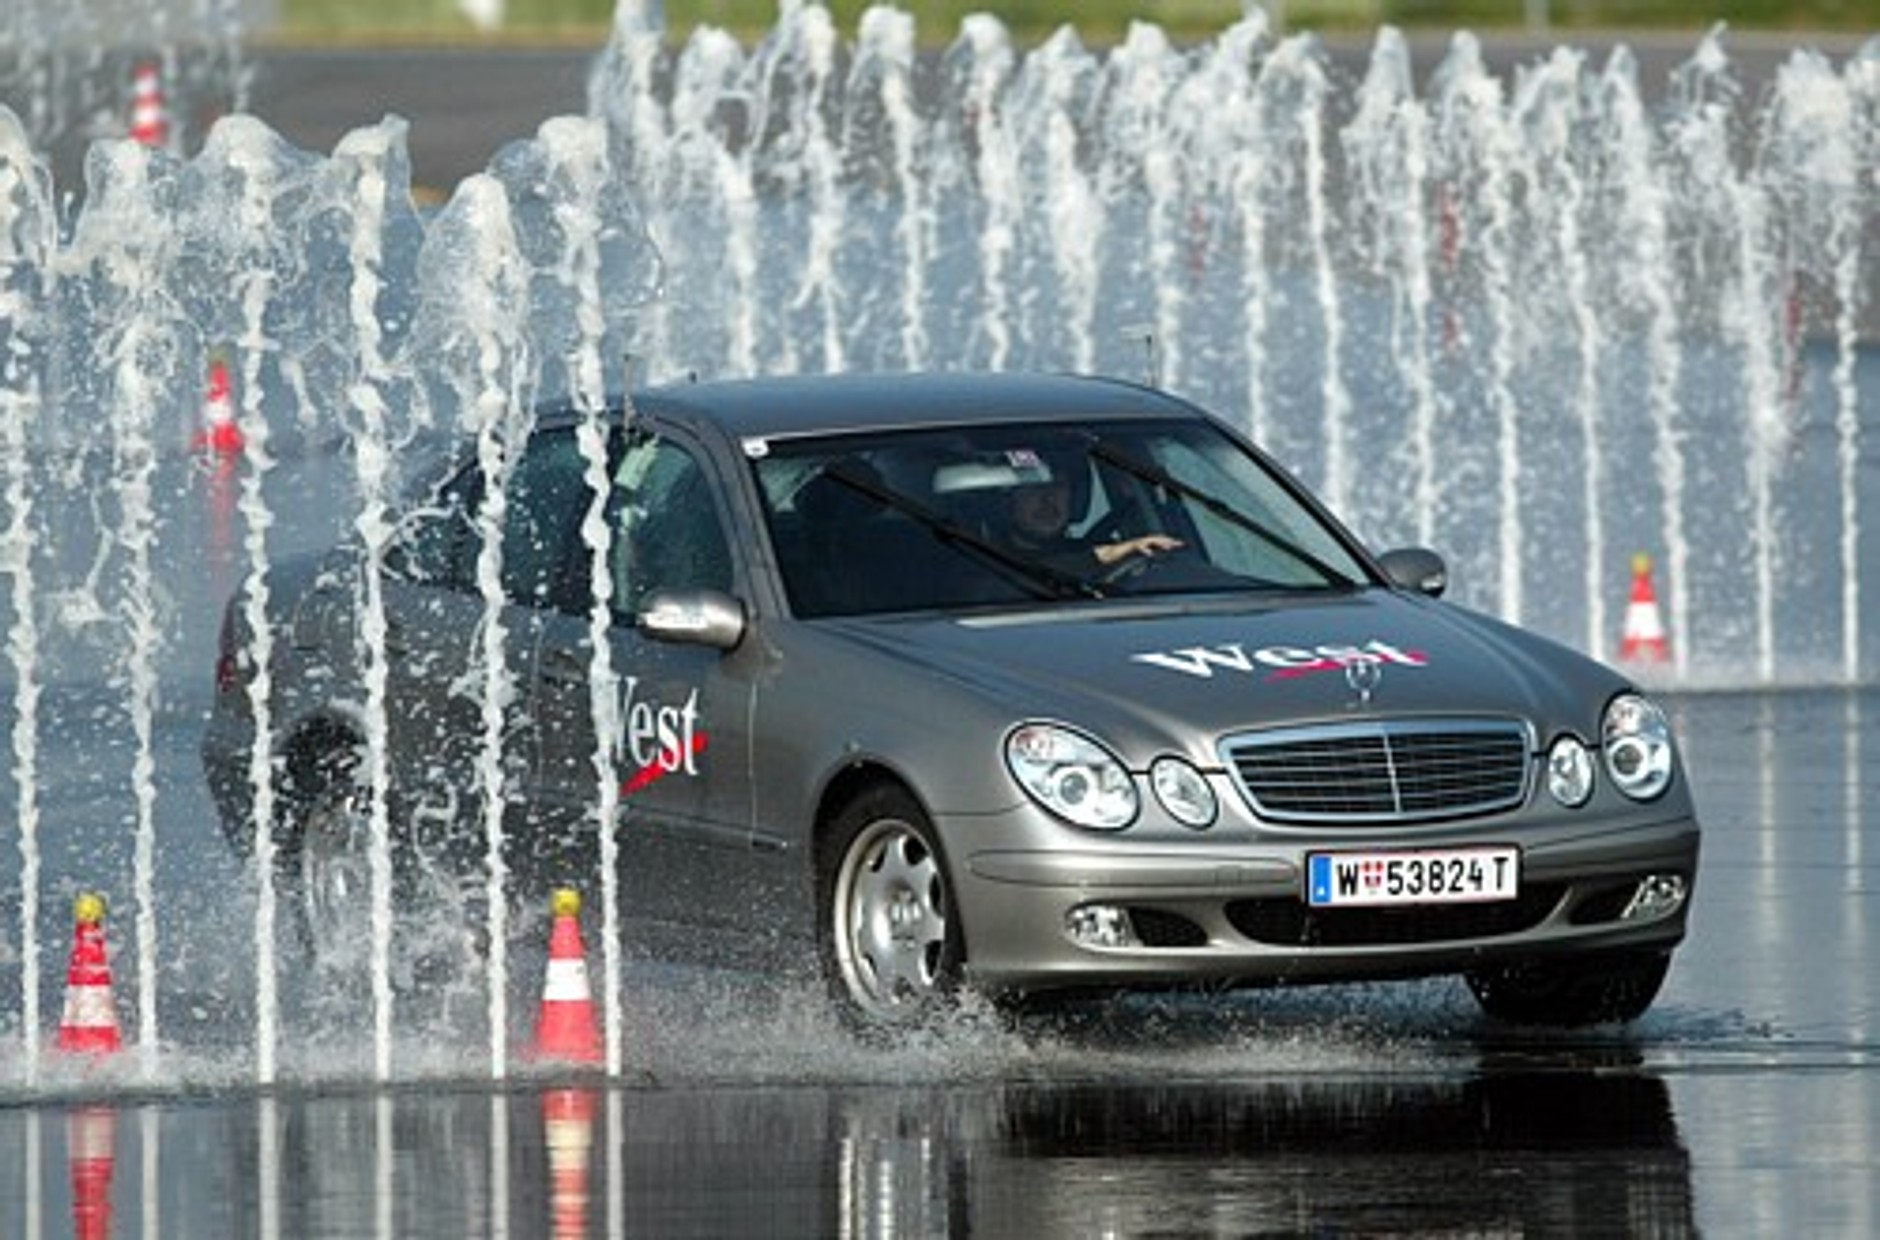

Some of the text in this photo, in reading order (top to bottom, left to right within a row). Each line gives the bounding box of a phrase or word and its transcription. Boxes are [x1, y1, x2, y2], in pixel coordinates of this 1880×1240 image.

[1130, 639, 1428, 678] West
[1336, 856, 1509, 896] W 53824 T
